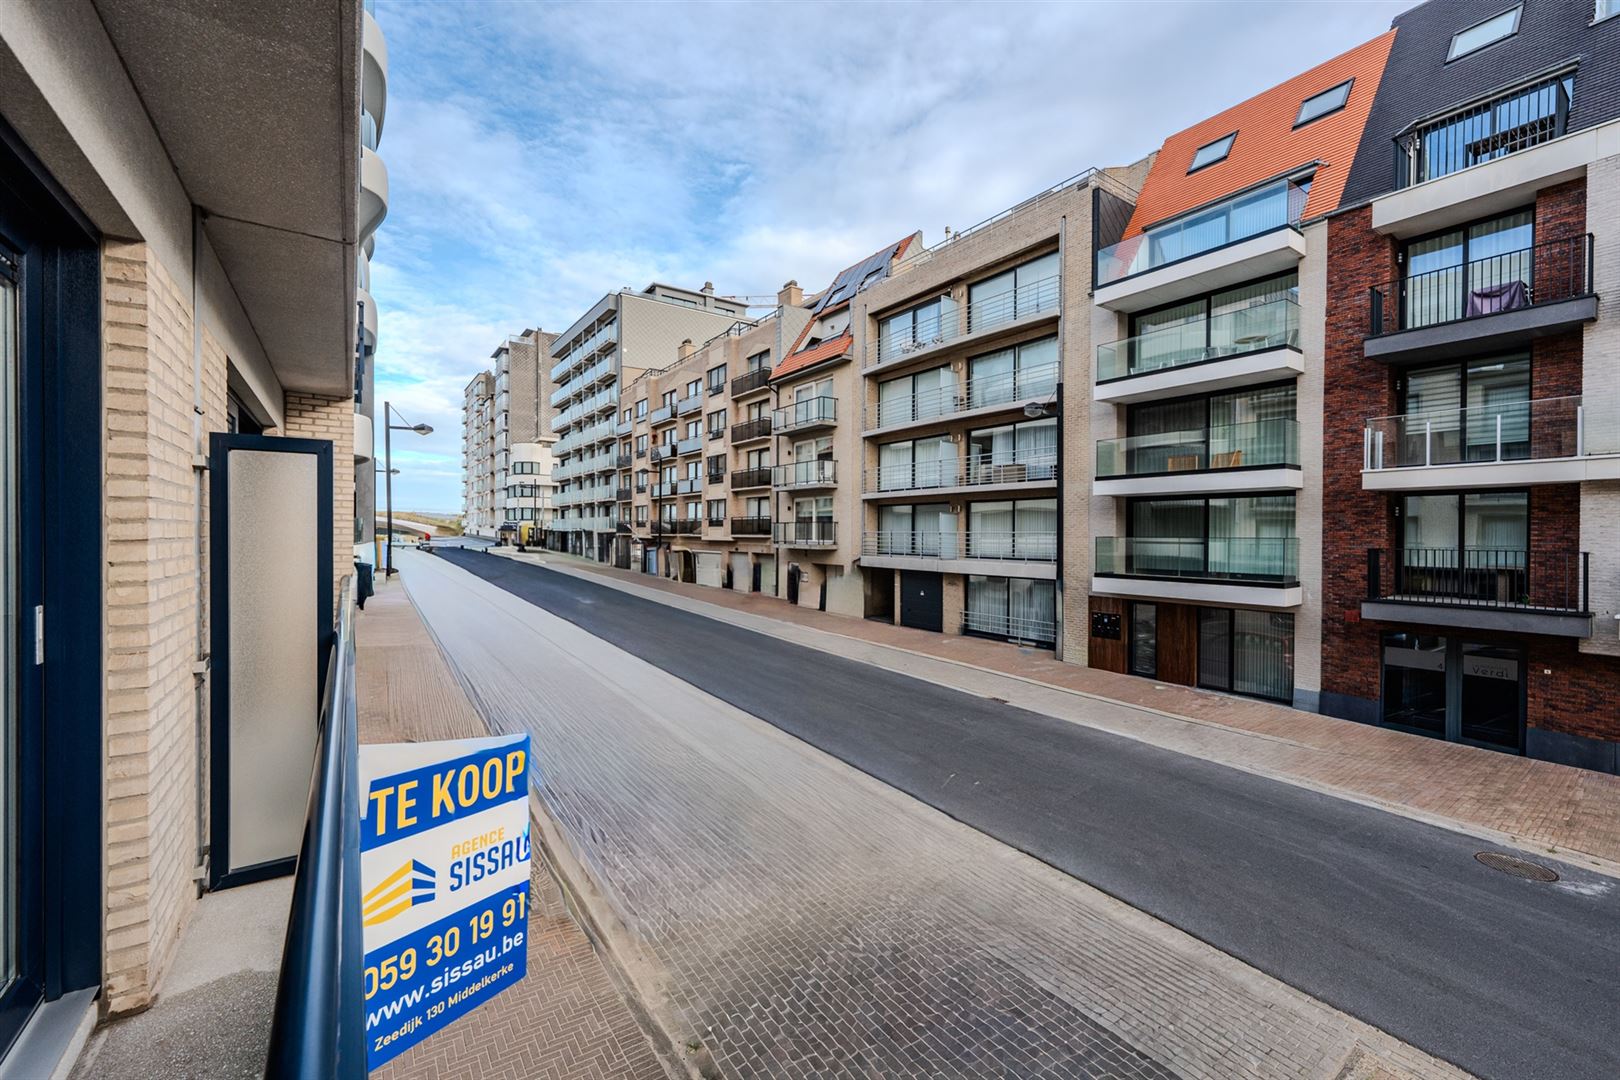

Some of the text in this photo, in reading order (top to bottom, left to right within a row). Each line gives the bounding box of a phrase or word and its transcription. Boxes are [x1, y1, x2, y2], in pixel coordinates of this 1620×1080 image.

[1472, 665, 1509, 678] Verdi
[369, 750, 526, 836] TE KOOP
[451, 827, 505, 859] AGENCE
[364, 892, 526, 1000] 059 30 19 91
[366, 931, 524, 1031] www.sissau.be
[374, 962, 514, 1052] Zeedijk 130 Middelkerke
